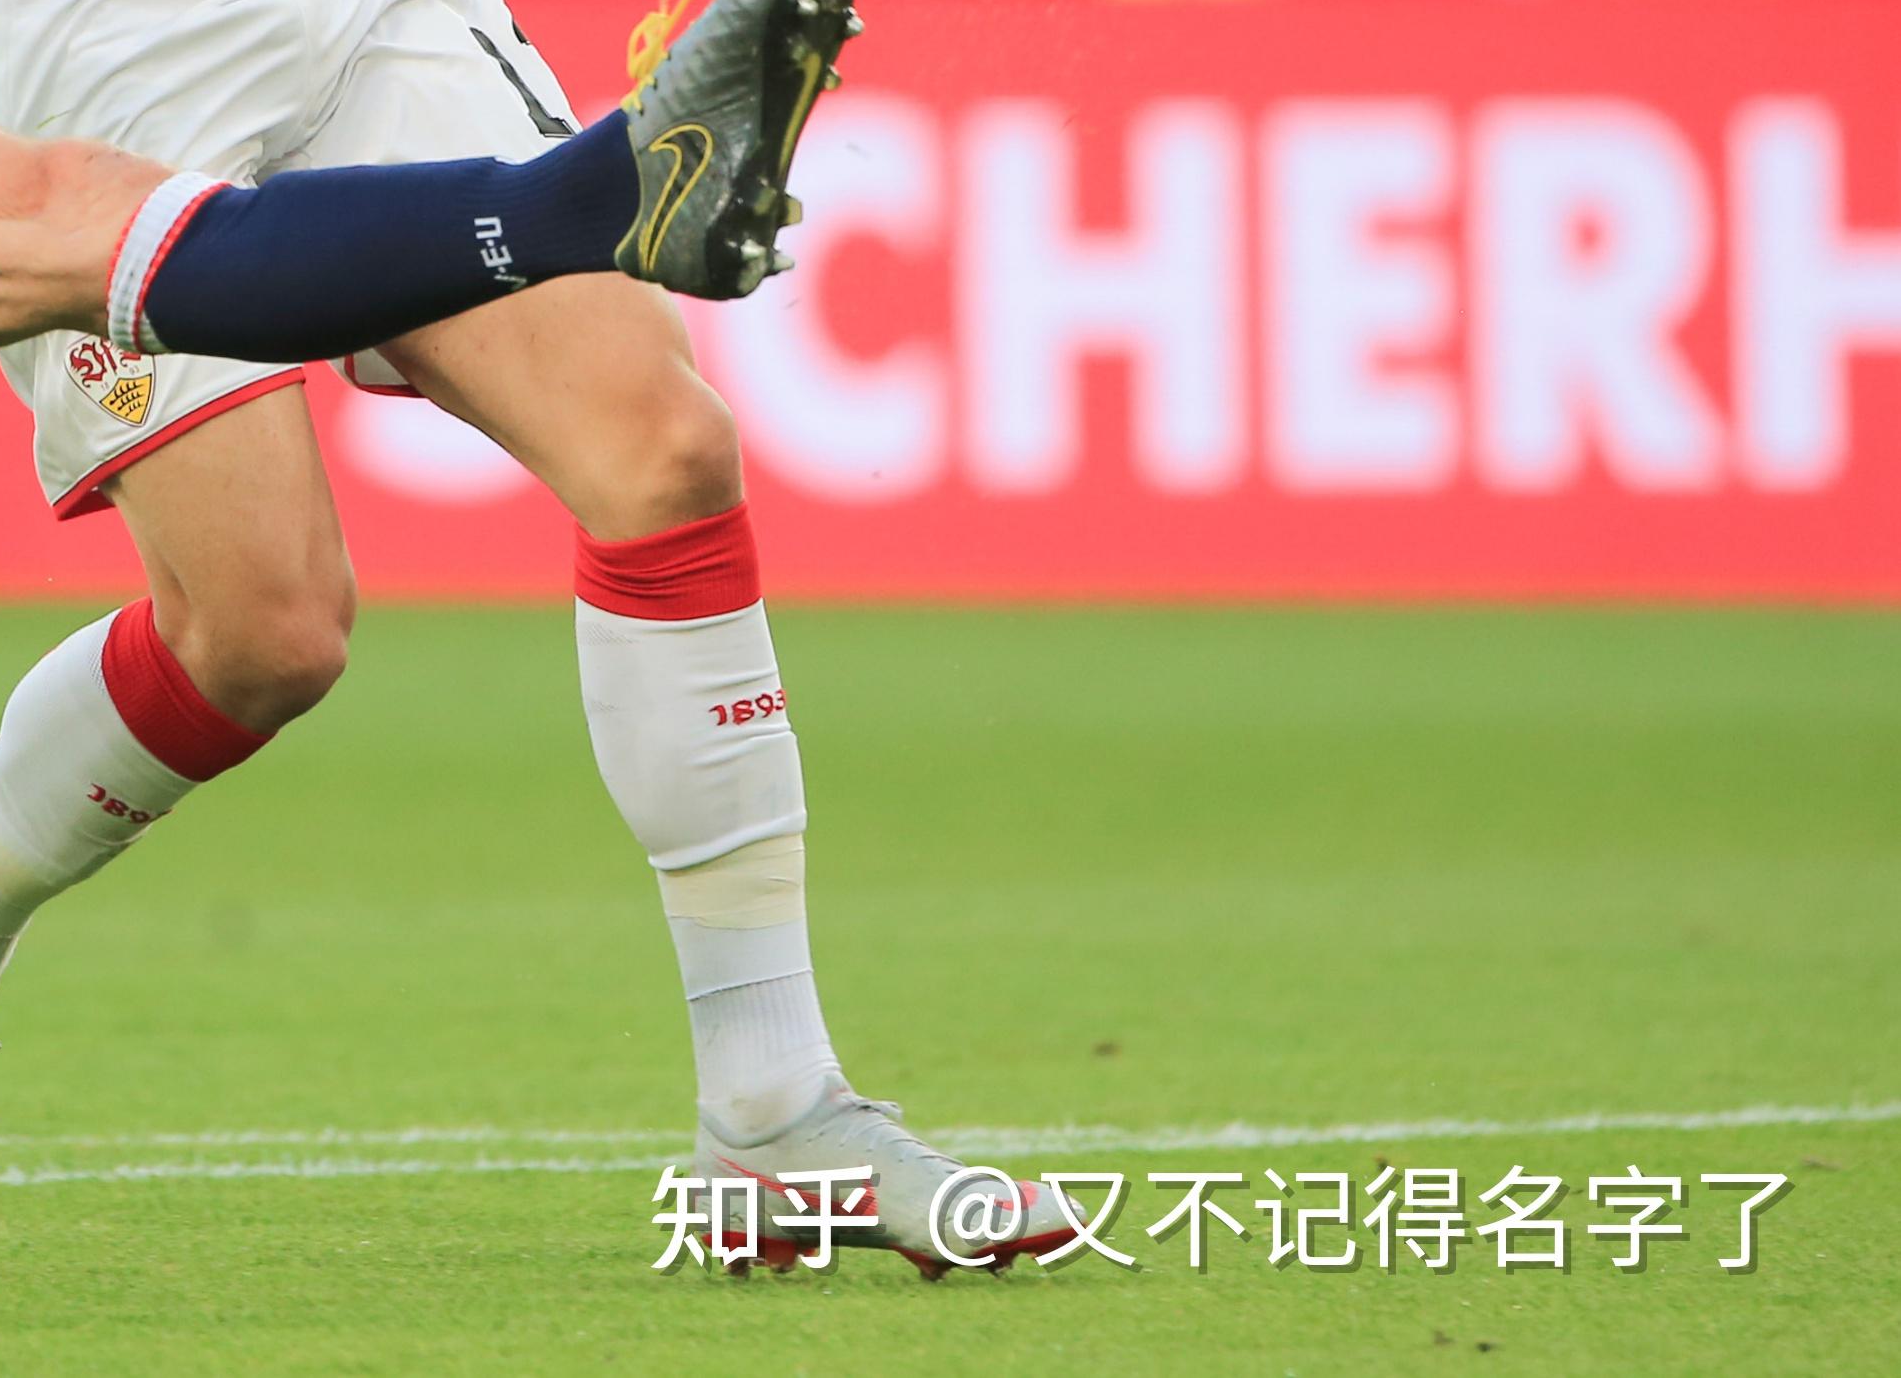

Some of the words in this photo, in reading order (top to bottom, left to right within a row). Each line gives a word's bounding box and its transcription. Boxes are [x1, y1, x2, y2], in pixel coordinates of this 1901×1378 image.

[338, 87, 1901, 508] CHERH
[708, 688, 786, 727] 1893
[87, 782, 173, 825] 189
